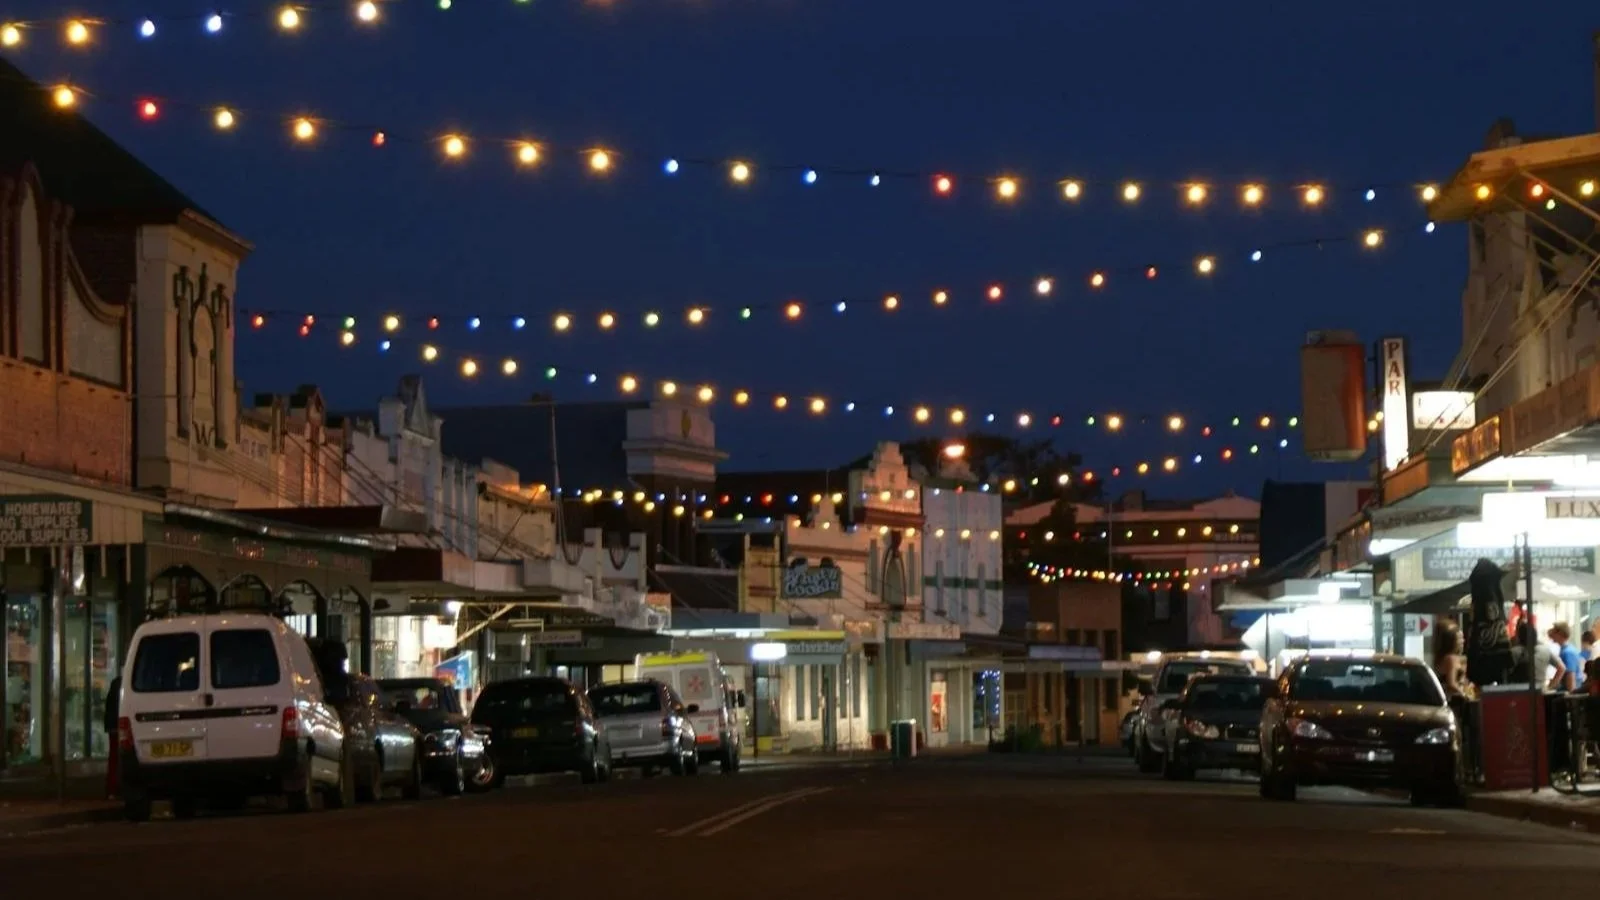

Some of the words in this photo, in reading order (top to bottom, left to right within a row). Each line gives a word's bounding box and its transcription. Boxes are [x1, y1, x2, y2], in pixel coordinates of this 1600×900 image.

[5, 501, 82, 516] HOMEWARES
[20, 515, 79, 529] SUPPLIES
[30, 528, 89, 542] SUPPLIES
